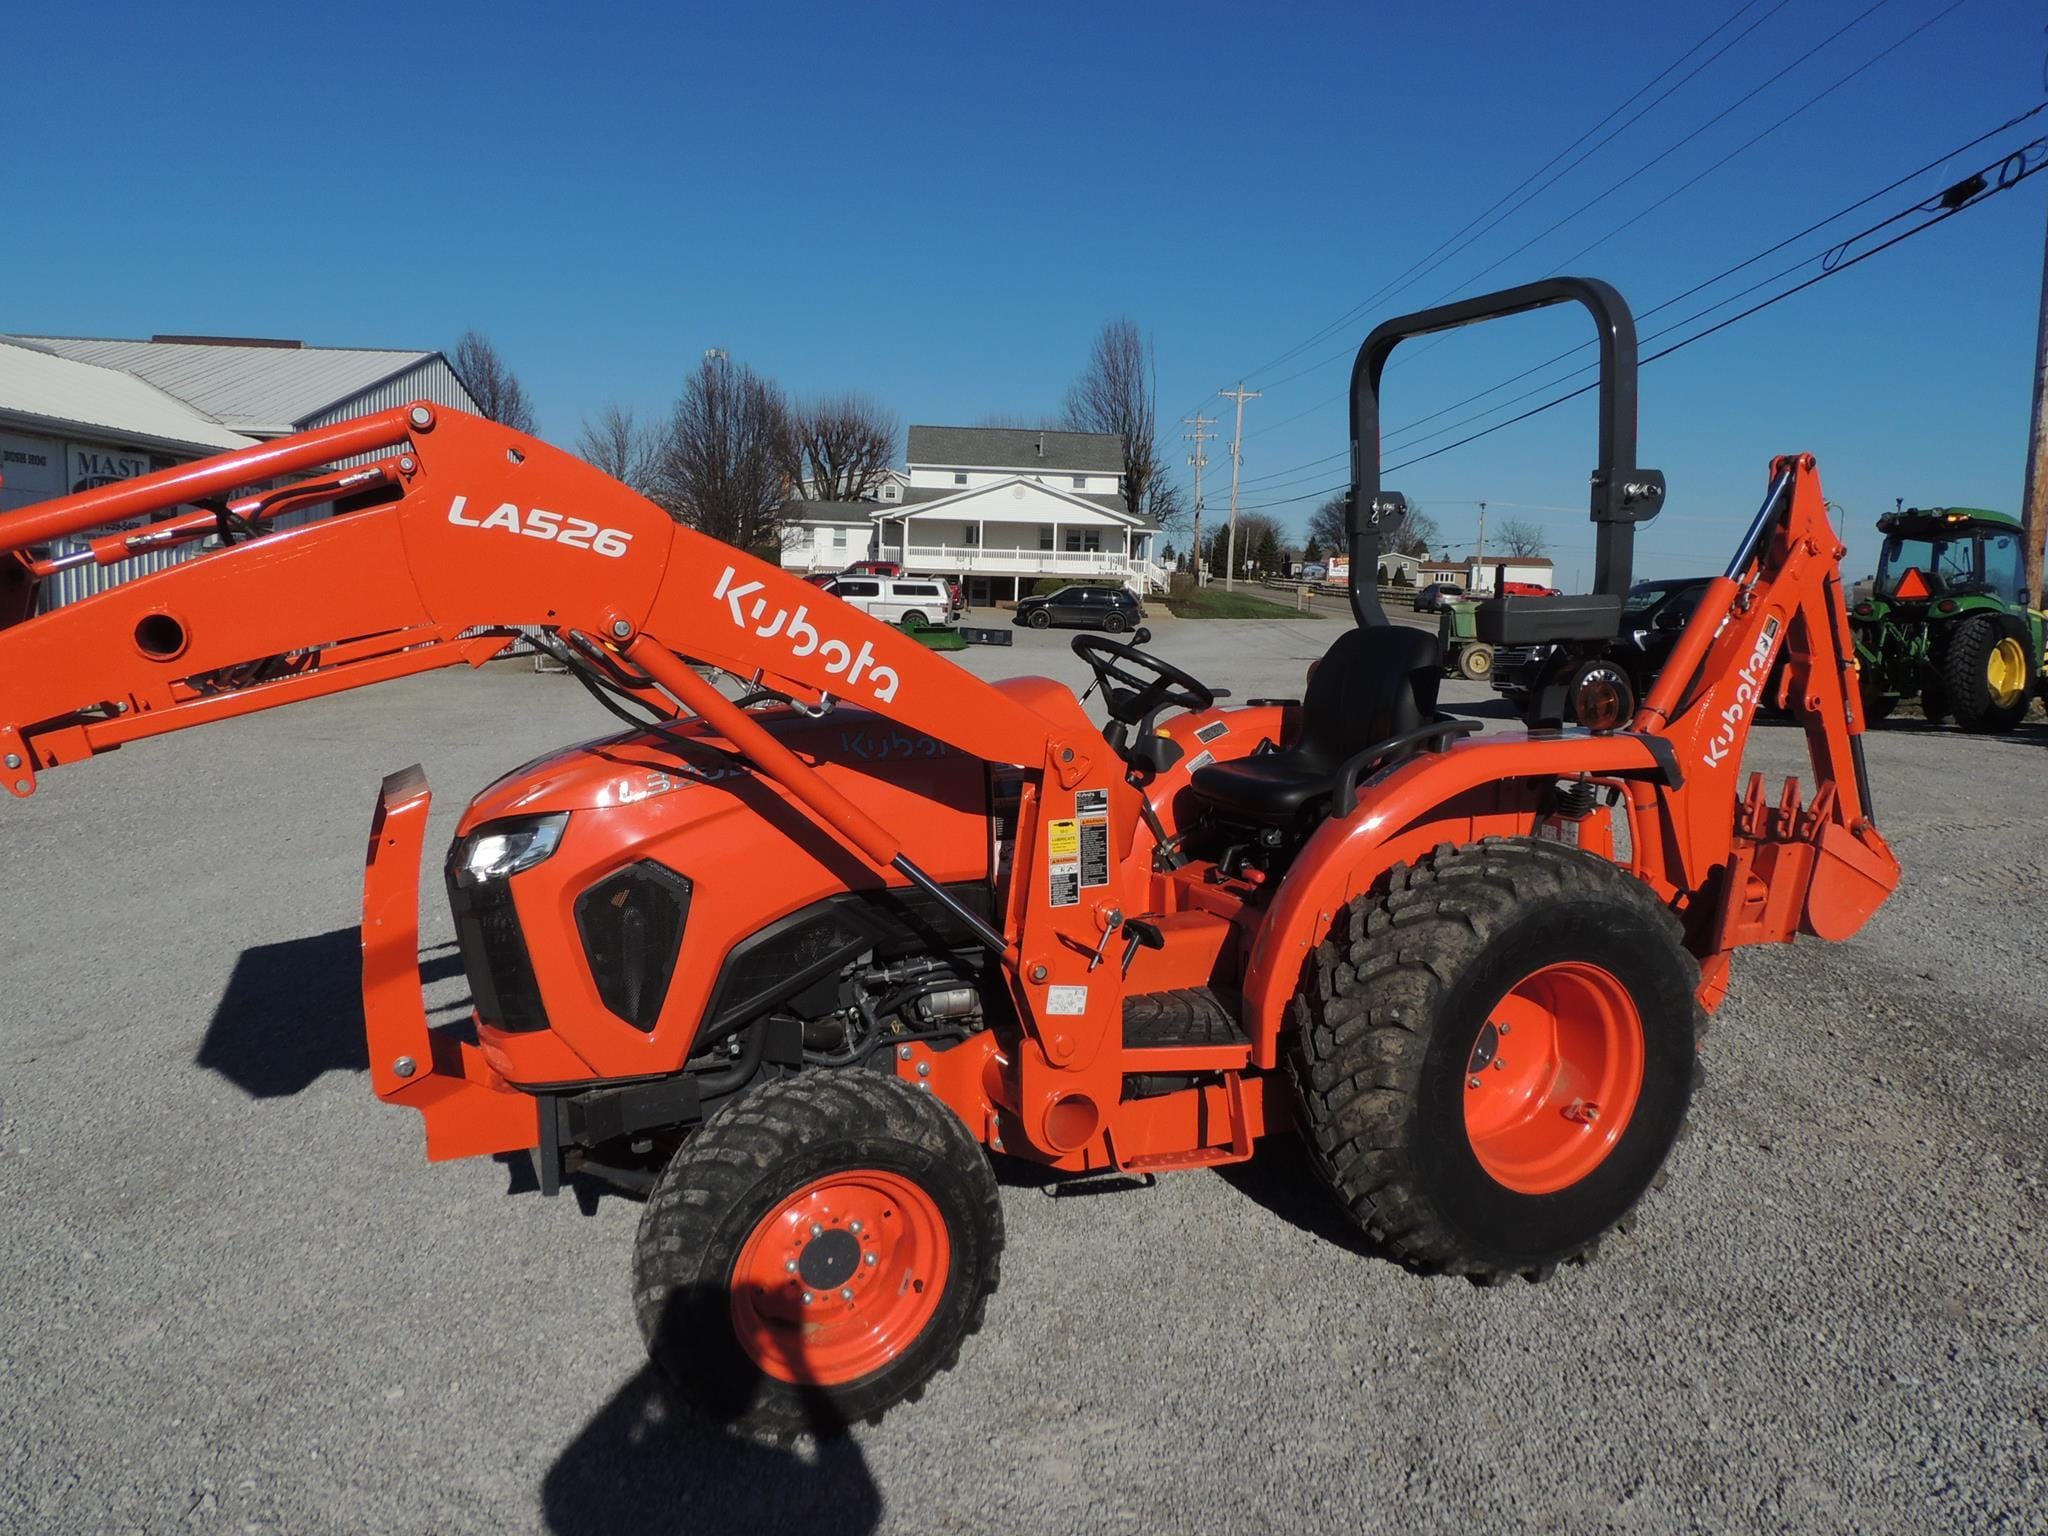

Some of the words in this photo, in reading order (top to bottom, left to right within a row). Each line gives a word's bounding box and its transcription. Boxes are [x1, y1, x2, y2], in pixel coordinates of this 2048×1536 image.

[28, 454, 47, 467] HOG
[77, 451, 145, 478] MAST
[447, 495, 634, 559] LA526
[712, 565, 900, 704] Kubota
[1702, 652, 1767, 769] Kubota
[840, 730, 948, 759] Kubo
